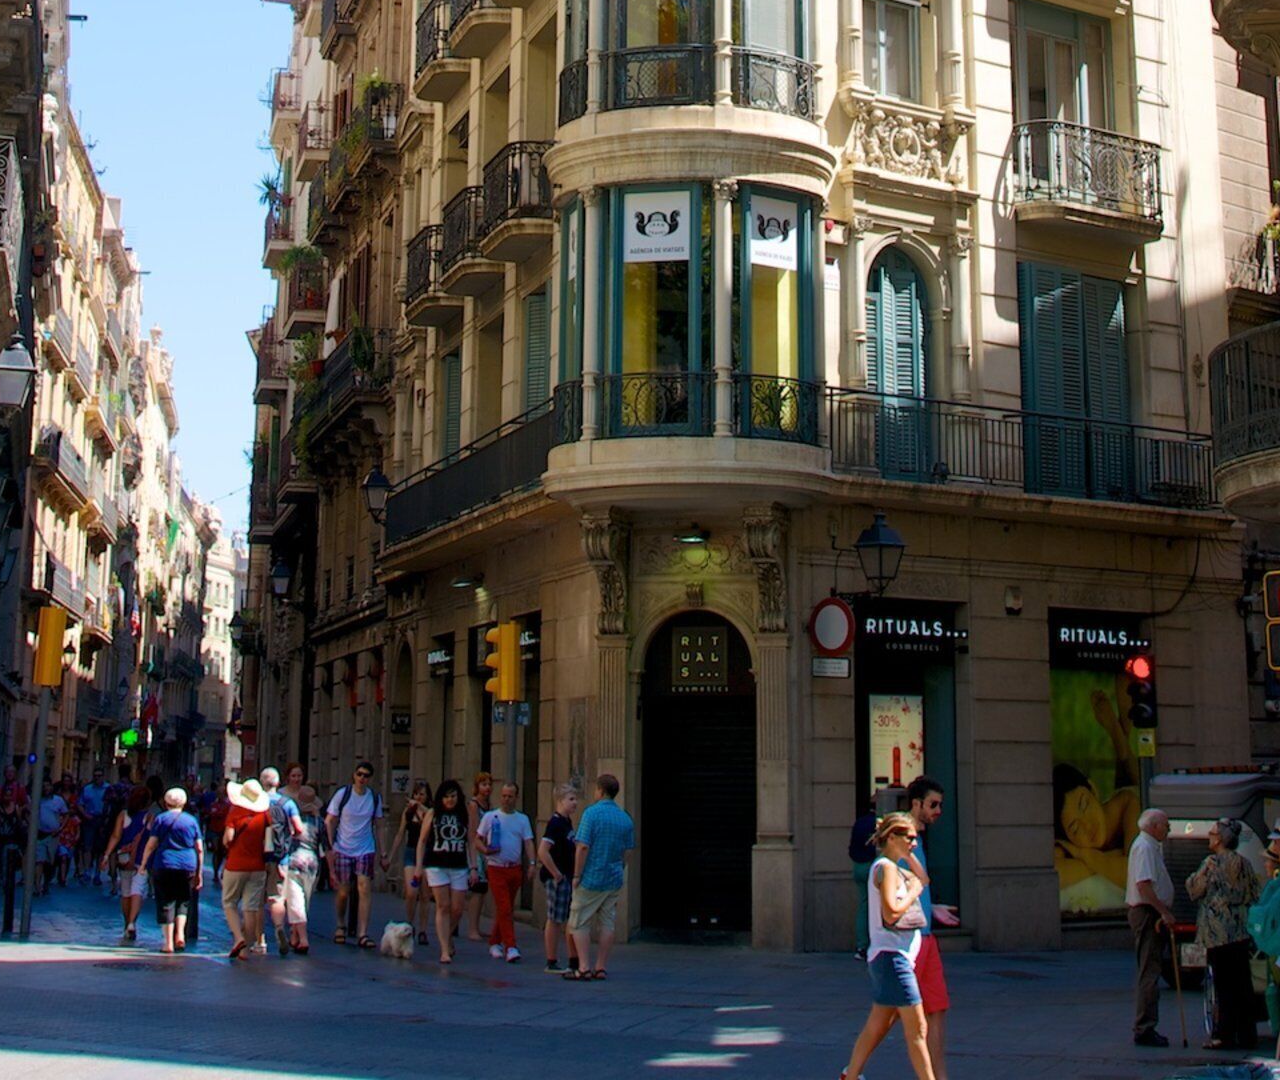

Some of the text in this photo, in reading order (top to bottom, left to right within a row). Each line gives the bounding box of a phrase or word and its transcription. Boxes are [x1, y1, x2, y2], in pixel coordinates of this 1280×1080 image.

[865, 618, 968, 638] RITUALS...
[1060, 627, 1149, 646] RITUALS...
[885, 642, 940, 652] cosmetics
